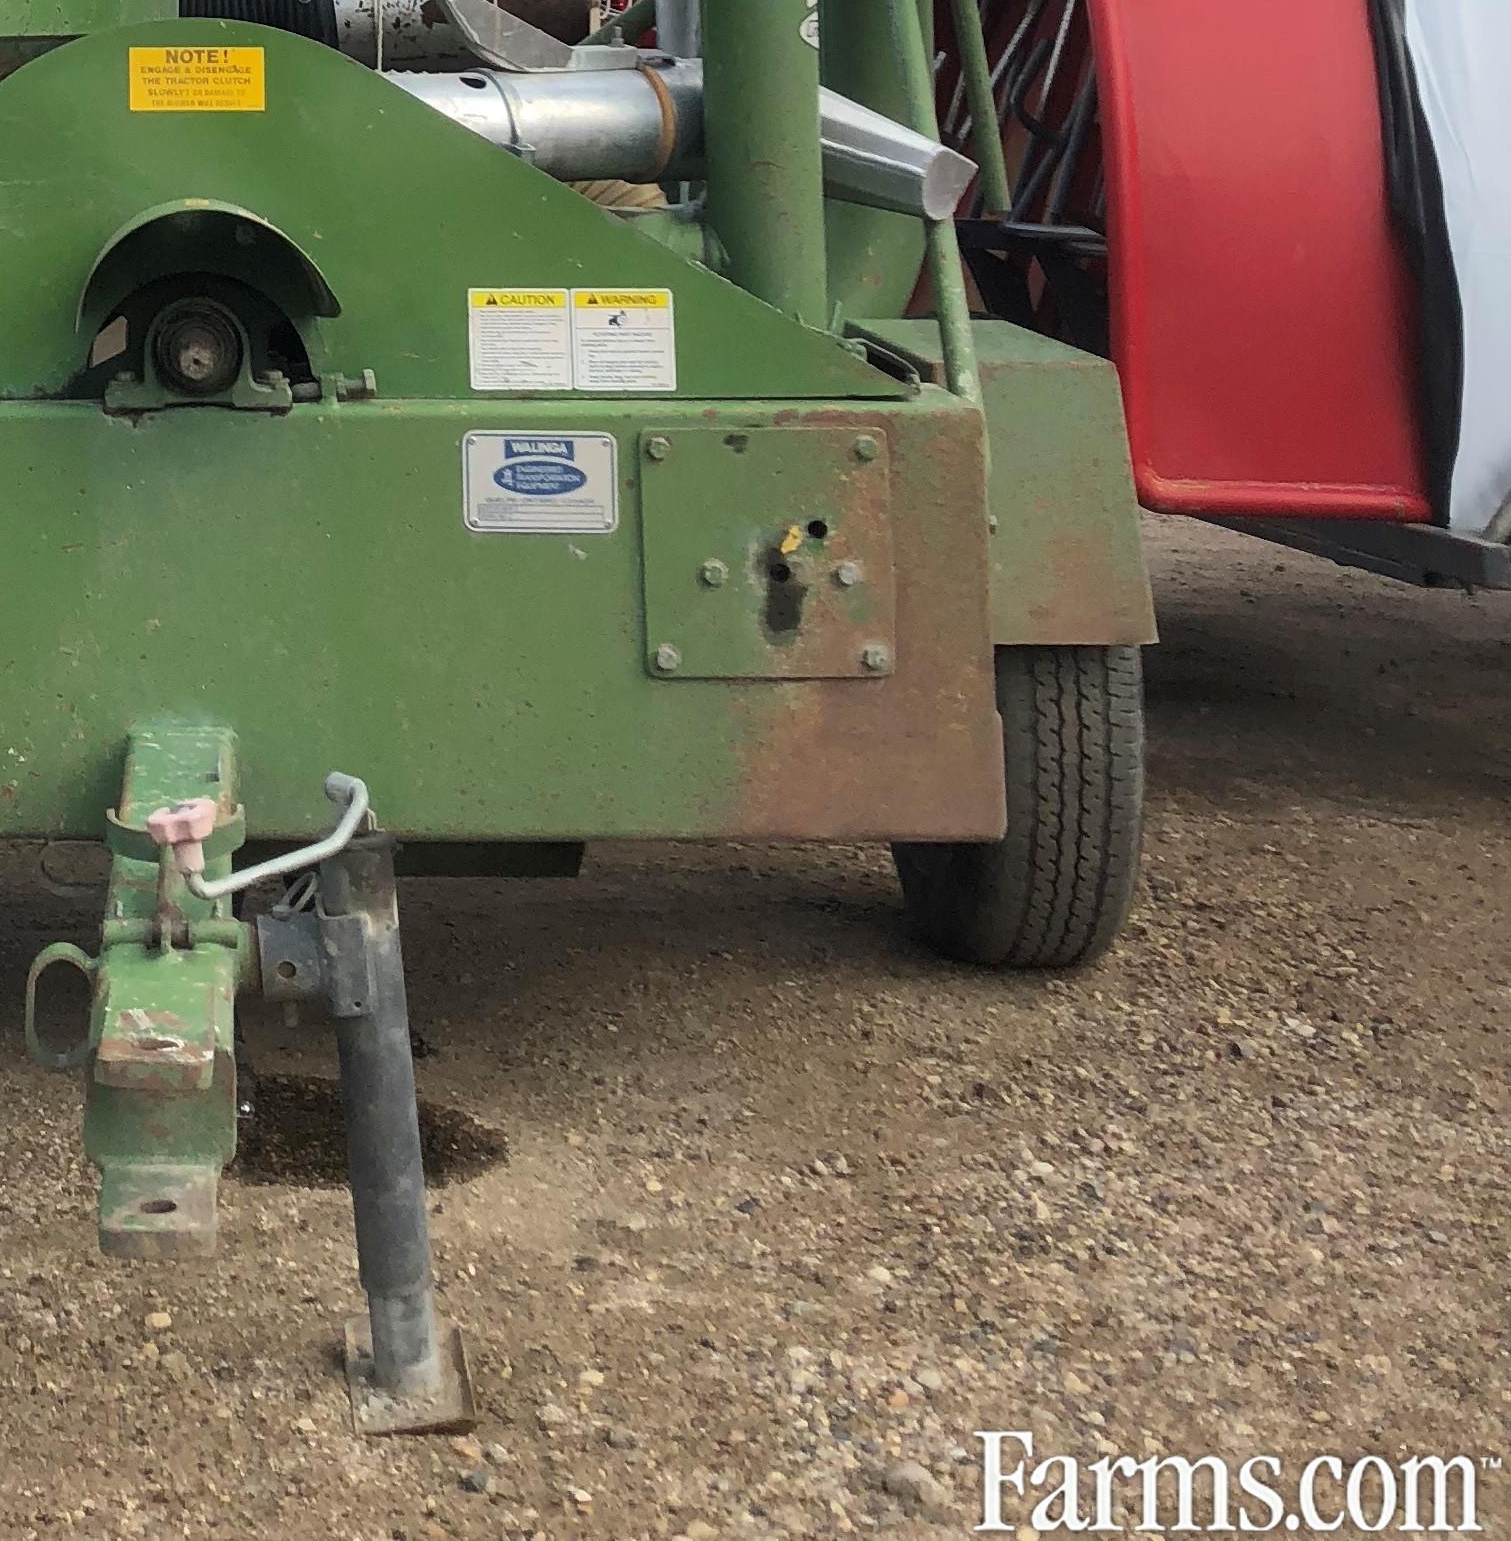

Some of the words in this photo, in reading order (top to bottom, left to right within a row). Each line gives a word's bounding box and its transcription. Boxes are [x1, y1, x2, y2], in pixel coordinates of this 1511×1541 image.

[140, 66, 181, 74] ENGAGE
[195, 65, 251, 74] DISENGAGE
[142, 77, 161, 85] THE
[166, 77, 209, 85] TRACTOR
[213, 77, 251, 85] CLUTCH
[499, 294, 556, 306] CAUTION
[599, 294, 657, 306] WARNING
[511, 441, 569, 454] WALINGA
